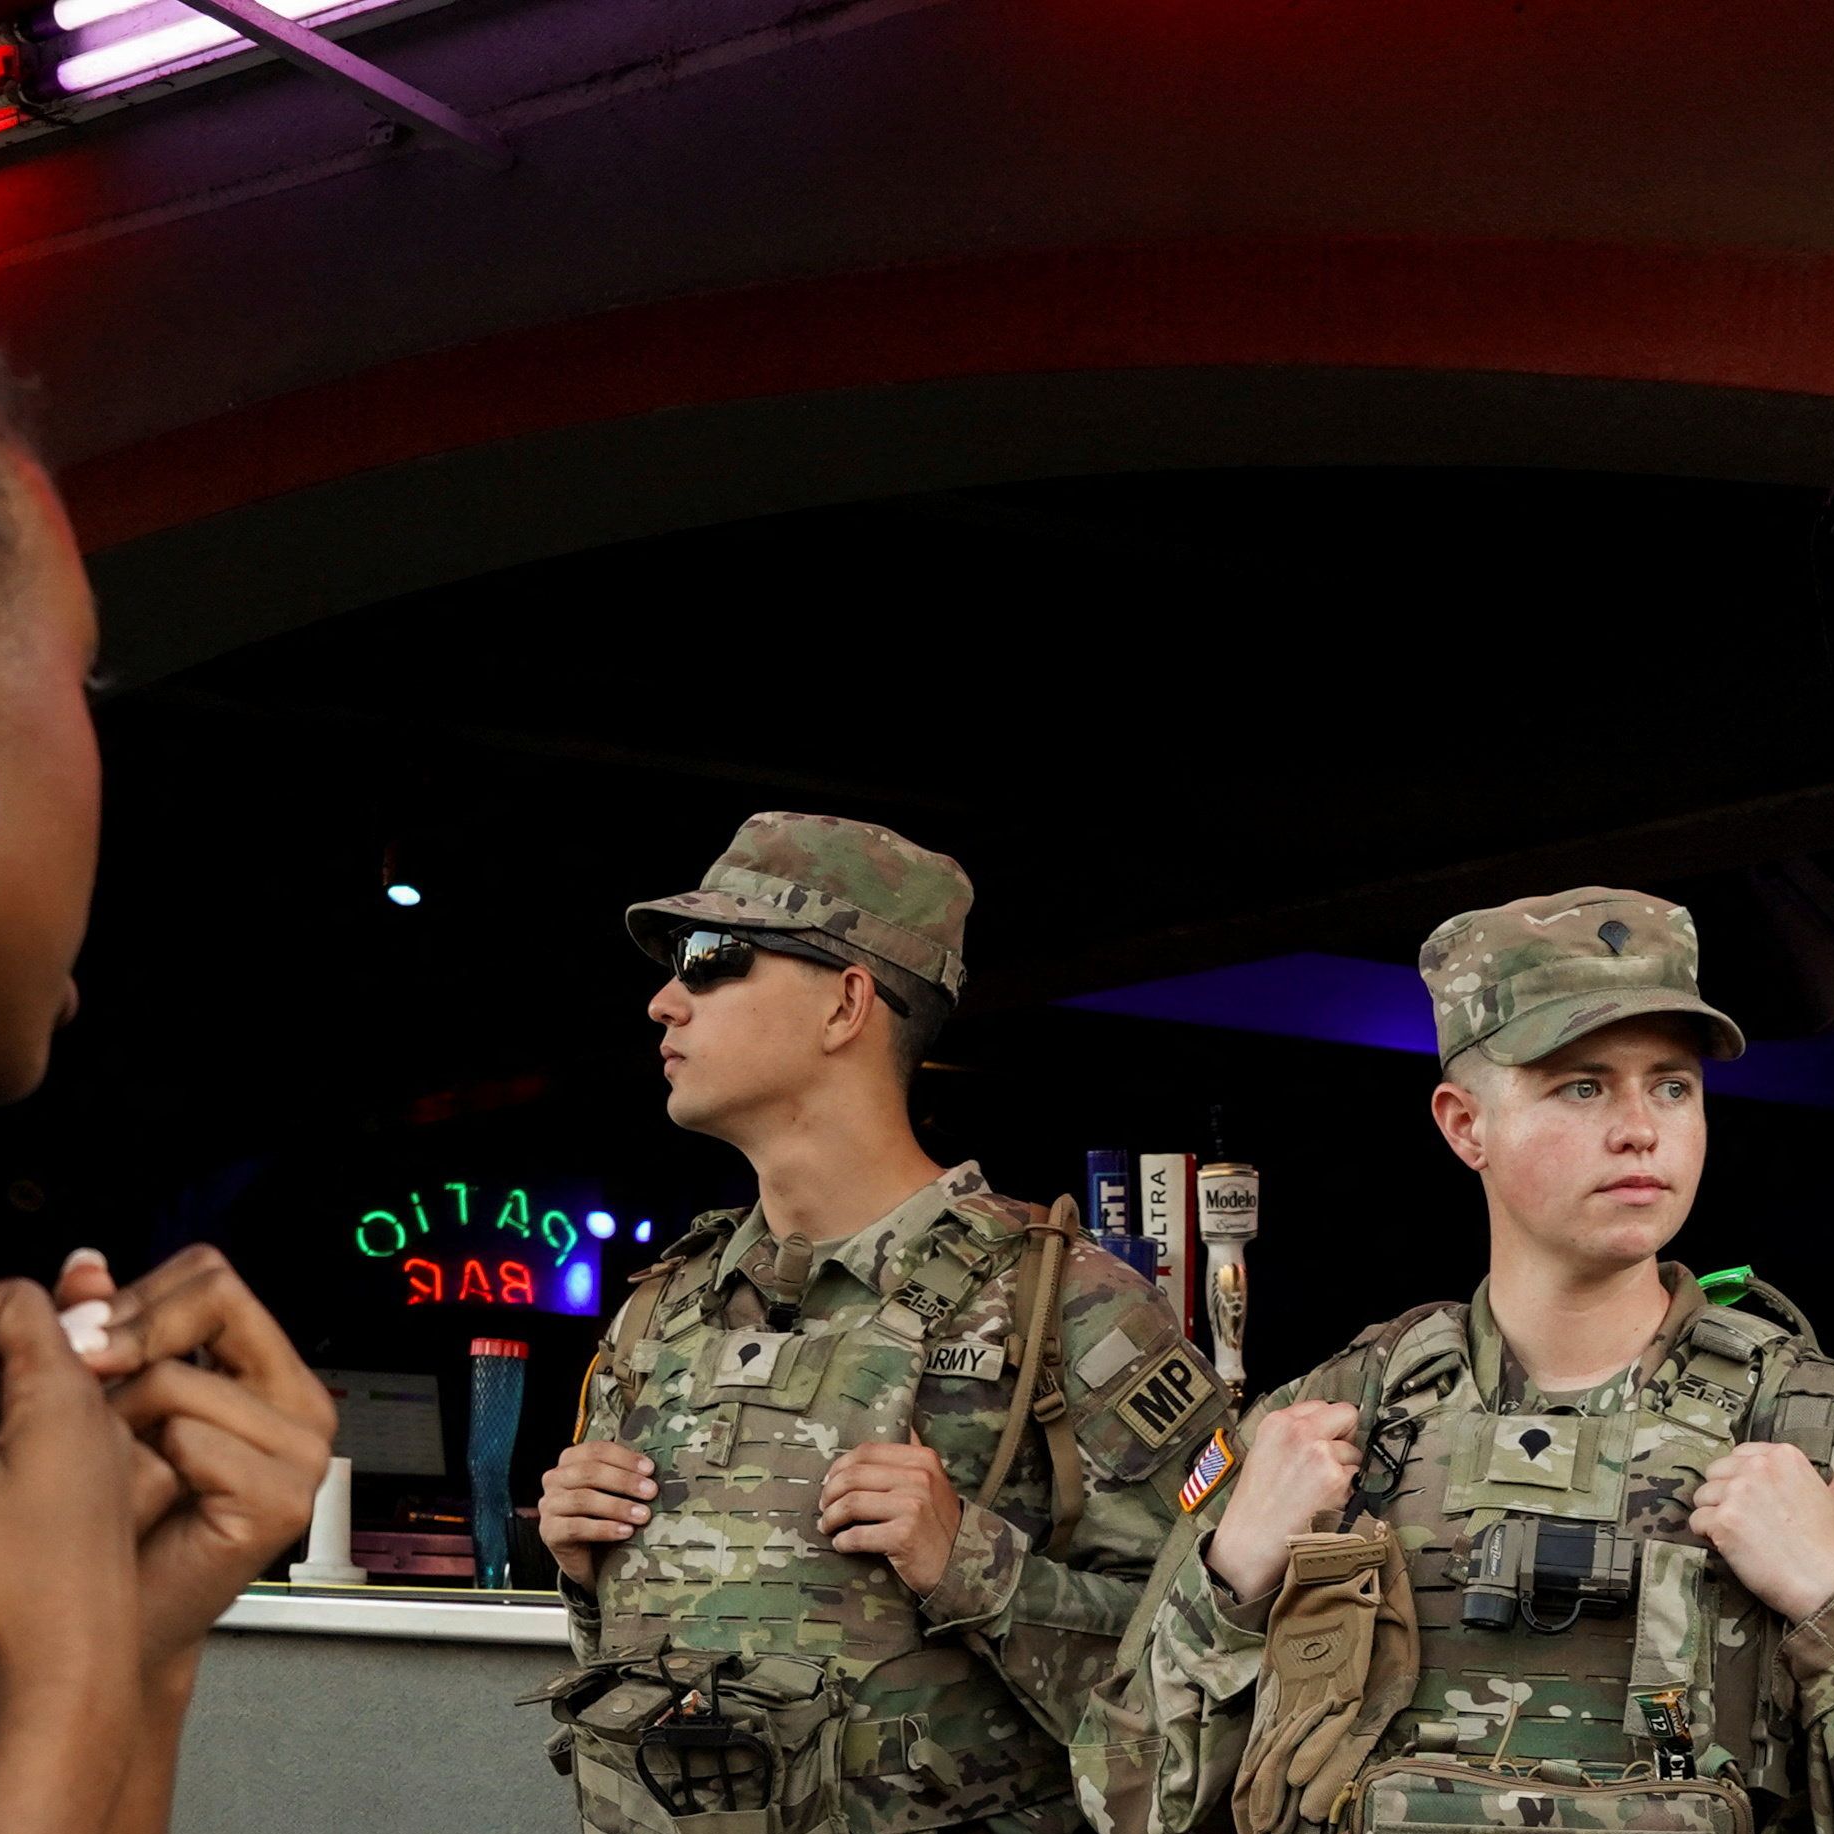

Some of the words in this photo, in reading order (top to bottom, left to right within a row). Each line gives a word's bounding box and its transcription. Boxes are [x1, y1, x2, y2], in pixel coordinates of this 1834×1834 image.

[1100, 1181, 1126, 1235] HT
[1151, 1168, 1167, 1258] ULTRA
[1205, 1190, 1257, 1209] Modelo
[1128, 1359, 1196, 1434] MP
[1651, 1716, 1667, 1732] 12
